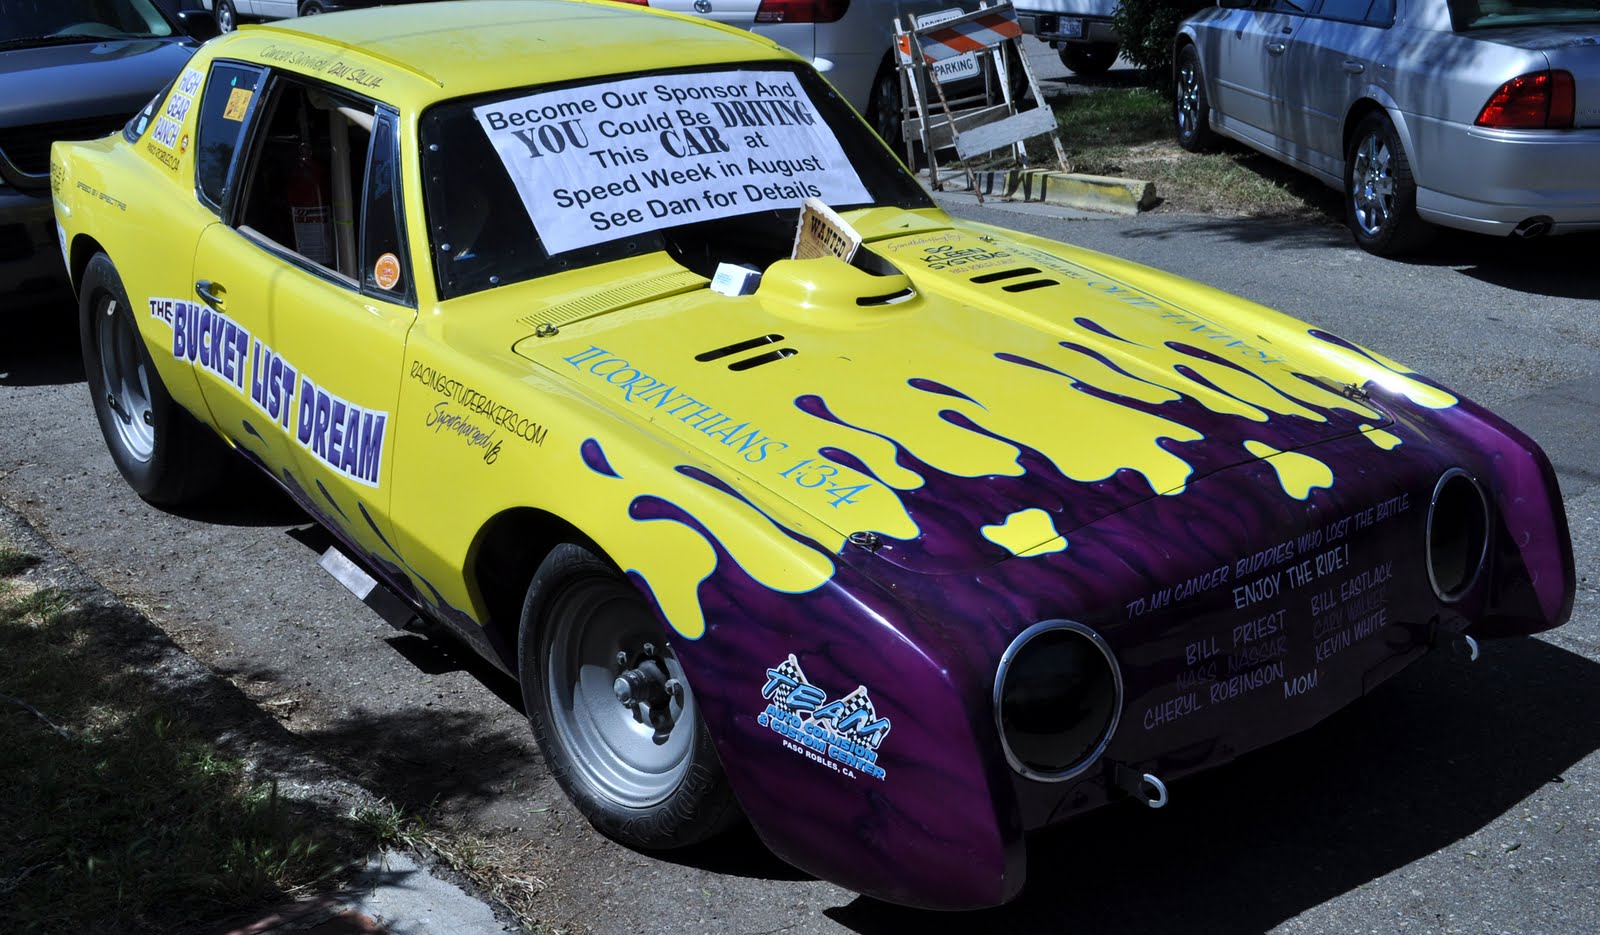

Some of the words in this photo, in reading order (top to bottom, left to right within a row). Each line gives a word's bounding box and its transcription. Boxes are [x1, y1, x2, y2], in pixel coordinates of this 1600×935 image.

[178, 68, 205, 96] HIGH
[327, 61, 352, 78] DAN
[934, 58, 974, 75] PARKING
[167, 93, 192, 122] GEAR
[486, 100, 597, 130] Become
[601, 91, 648, 109] Our
[653, 84, 748, 105] Sponsor
[755, 81, 797, 98] And
[511, 118, 589, 158] YOU
[598, 112, 674, 138] Could
[675, 109, 711, 127] Be
[711, 99, 817, 128] DRIVING
[152, 116, 181, 150] RANCH
[589, 146, 649, 169] This
[659, 126, 730, 158] CAR
[743, 131, 769, 149] at
[553, 174, 641, 209] Speed
[641, 163, 717, 189] Week
[716, 160, 743, 178] in
[747, 155, 825, 177] August
[589, 208, 644, 231] See
[646, 195, 701, 219] Dan
[702, 190, 738, 209] for
[742, 181, 823, 202] Details
[810, 215, 847, 258] WANTED
[920, 247, 988, 263] KLEEN
[924, 246, 954, 254] SO
[928, 251, 1012, 270] SYSTEMS
[149, 300, 174, 324] THE
[173, 302, 249, 390] BUCKET
[251, 340, 297, 431] LIST
[297, 375, 387, 484] DREAM
[410, 360, 548, 447] RACINGSTUDEBAKERS.COM
[426, 401, 496, 447] Supercharged
[562, 345, 615, 371] II
[590, 357, 789, 463] CORINTHIANS
[778, 458, 873, 509] 1:3-4
[1126, 597, 1145, 619] TO
[1147, 587, 1171, 612] MY
[1174, 565, 1229, 601] CANCER
[1235, 540, 1294, 579] BUDDIES
[1297, 528, 1322, 554] WHO
[1325, 516, 1352, 543] LOST
[1354, 507, 1374, 531] THE
[1376, 492, 1410, 523] BATTLE
[1232, 571, 1281, 610] ENJOY
[1285, 559, 1313, 589] THE
[1315, 543, 1350, 577] RIDE!
[1311, 592, 1337, 618] BILL
[1340, 559, 1393, 602] EASTLACK
[1185, 636, 1220, 666] BILL
[1233, 609, 1287, 647] PRIEST
[1315, 627, 1351, 664] KEVIN
[1353, 607, 1388, 641] WHITE
[762, 669, 890, 748] TEAM
[1143, 694, 1202, 731] CHERYL
[1210, 661, 1284, 705] ROBINSON
[1284, 668, 1319, 700] MOM
[757, 713, 769, 727] &
[771, 718, 826, 754] CUSTOM
[828, 746, 886, 780] CENTER
[766, 704, 802, 729] AUTO
[804, 722, 878, 764] COLLISION
[783, 739, 804, 755] PASO
[805, 750, 841, 774] ROBLES,
[842, 767, 858, 779] CA.
